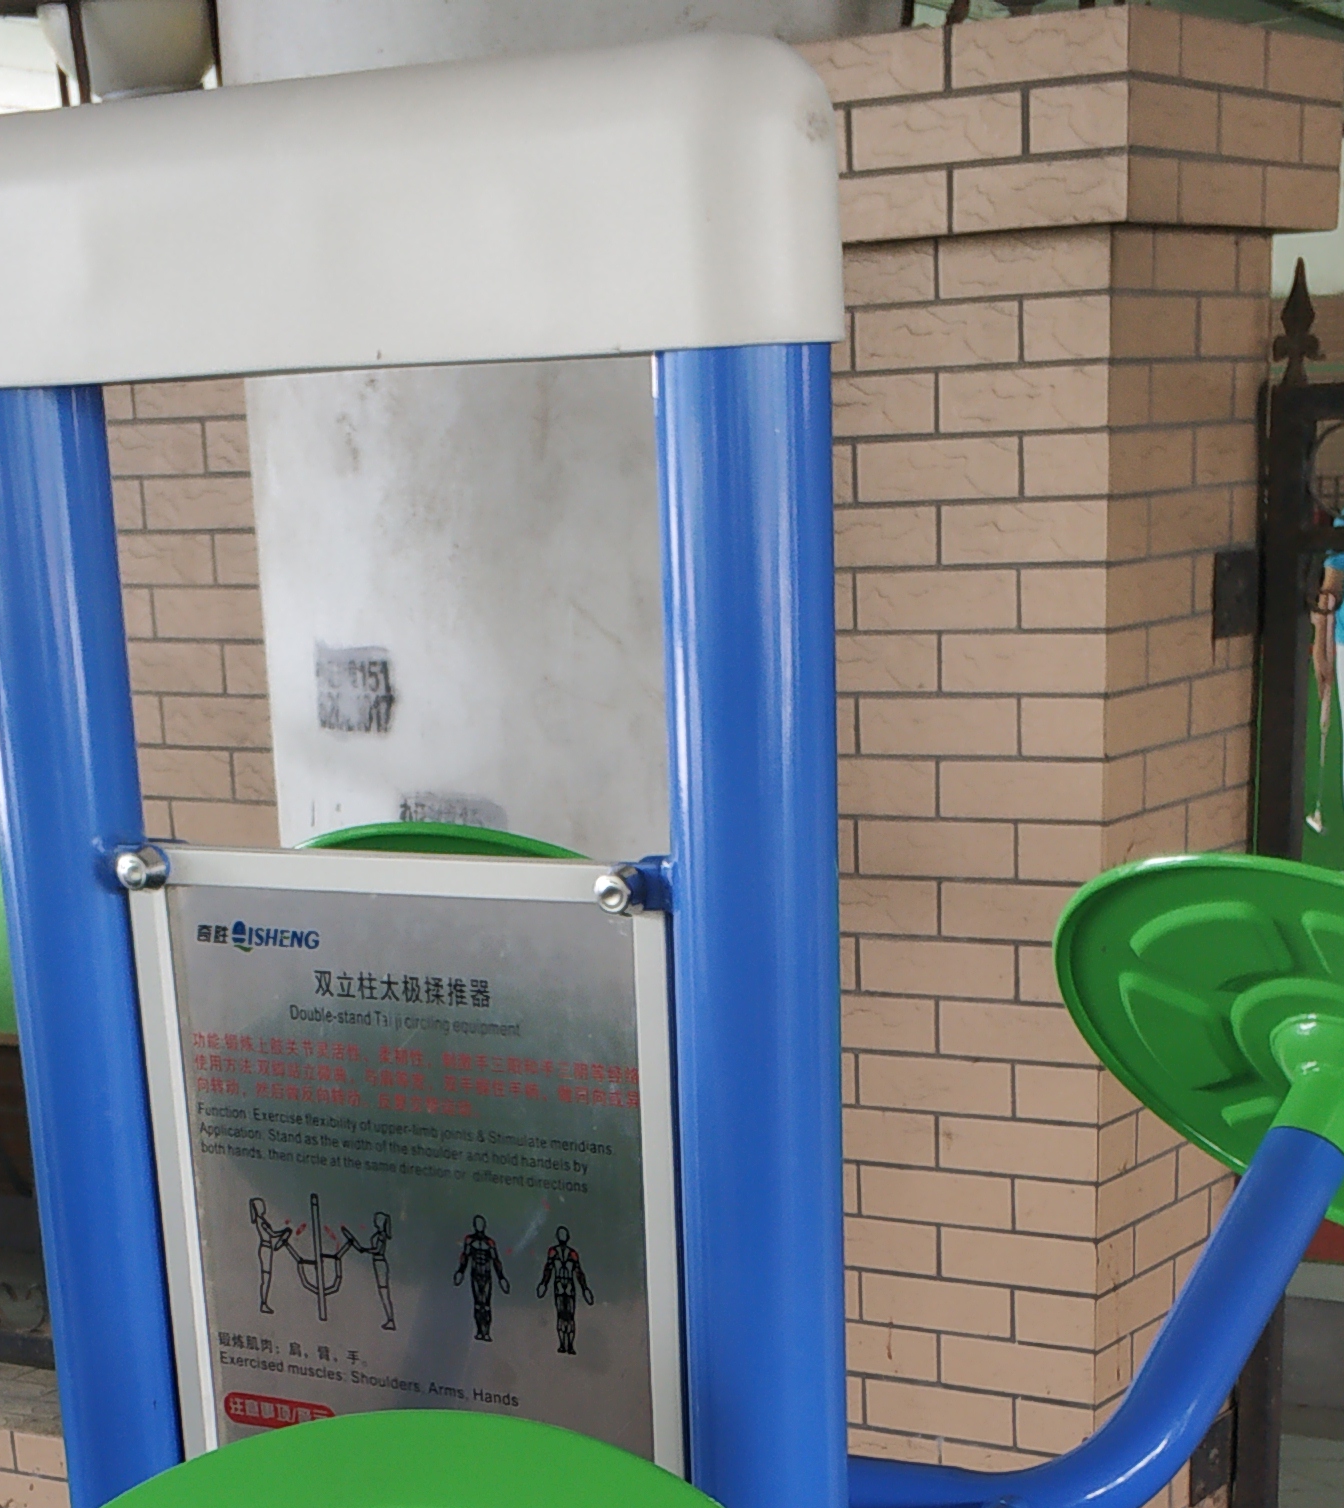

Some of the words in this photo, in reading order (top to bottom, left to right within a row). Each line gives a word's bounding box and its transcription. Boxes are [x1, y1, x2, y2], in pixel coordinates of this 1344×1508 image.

[197, 923, 230, 945] 奇胜
[313, 969, 491, 1008] 双立柱太极揉推器
[289, 1004, 371, 1026] Double-stand
[403, 1013, 449, 1036] circling
[452, 1018, 521, 1039] equipment
[253, 1107, 303, 1125] Exercise
[304, 1112, 357, 1133] flexibility
[359, 1117, 372, 1131] of
[373, 1122, 438, 1139] upper-limb
[476, 1129, 486, 1143] &
[488, 1130, 547, 1149] Stimulate
[201, 1141, 225, 1154] both
[268, 1148, 293, 1162] then
[296, 1152, 327, 1166] circle
[329, 1155, 341, 1167] at
[343, 1156, 362, 1170] the
[365, 1160, 396, 1172] same
[399, 1162, 451, 1178] direction
[454, 1168, 466, 1180] or
[472, 1169, 524, 1187] different
[526, 1176, 588, 1194] directions
[268, 1128, 302, 1144] Stand
[304, 1134, 319, 1146] as
[320, 1134, 338, 1148] the
[342, 1138, 373, 1151] width
[375, 1140, 387, 1152] of
[389, 1141, 407, 1155] the
[411, 1144, 463, 1160] shoulder
[467, 1151, 488, 1163] and
[492, 1151, 518, 1166] hold
[521, 1155, 571, 1172] handels
[573, 1159, 588, 1175] by
[219, 1350, 284, 1373] Exercised
[472, 1387, 519, 1407] Hands
